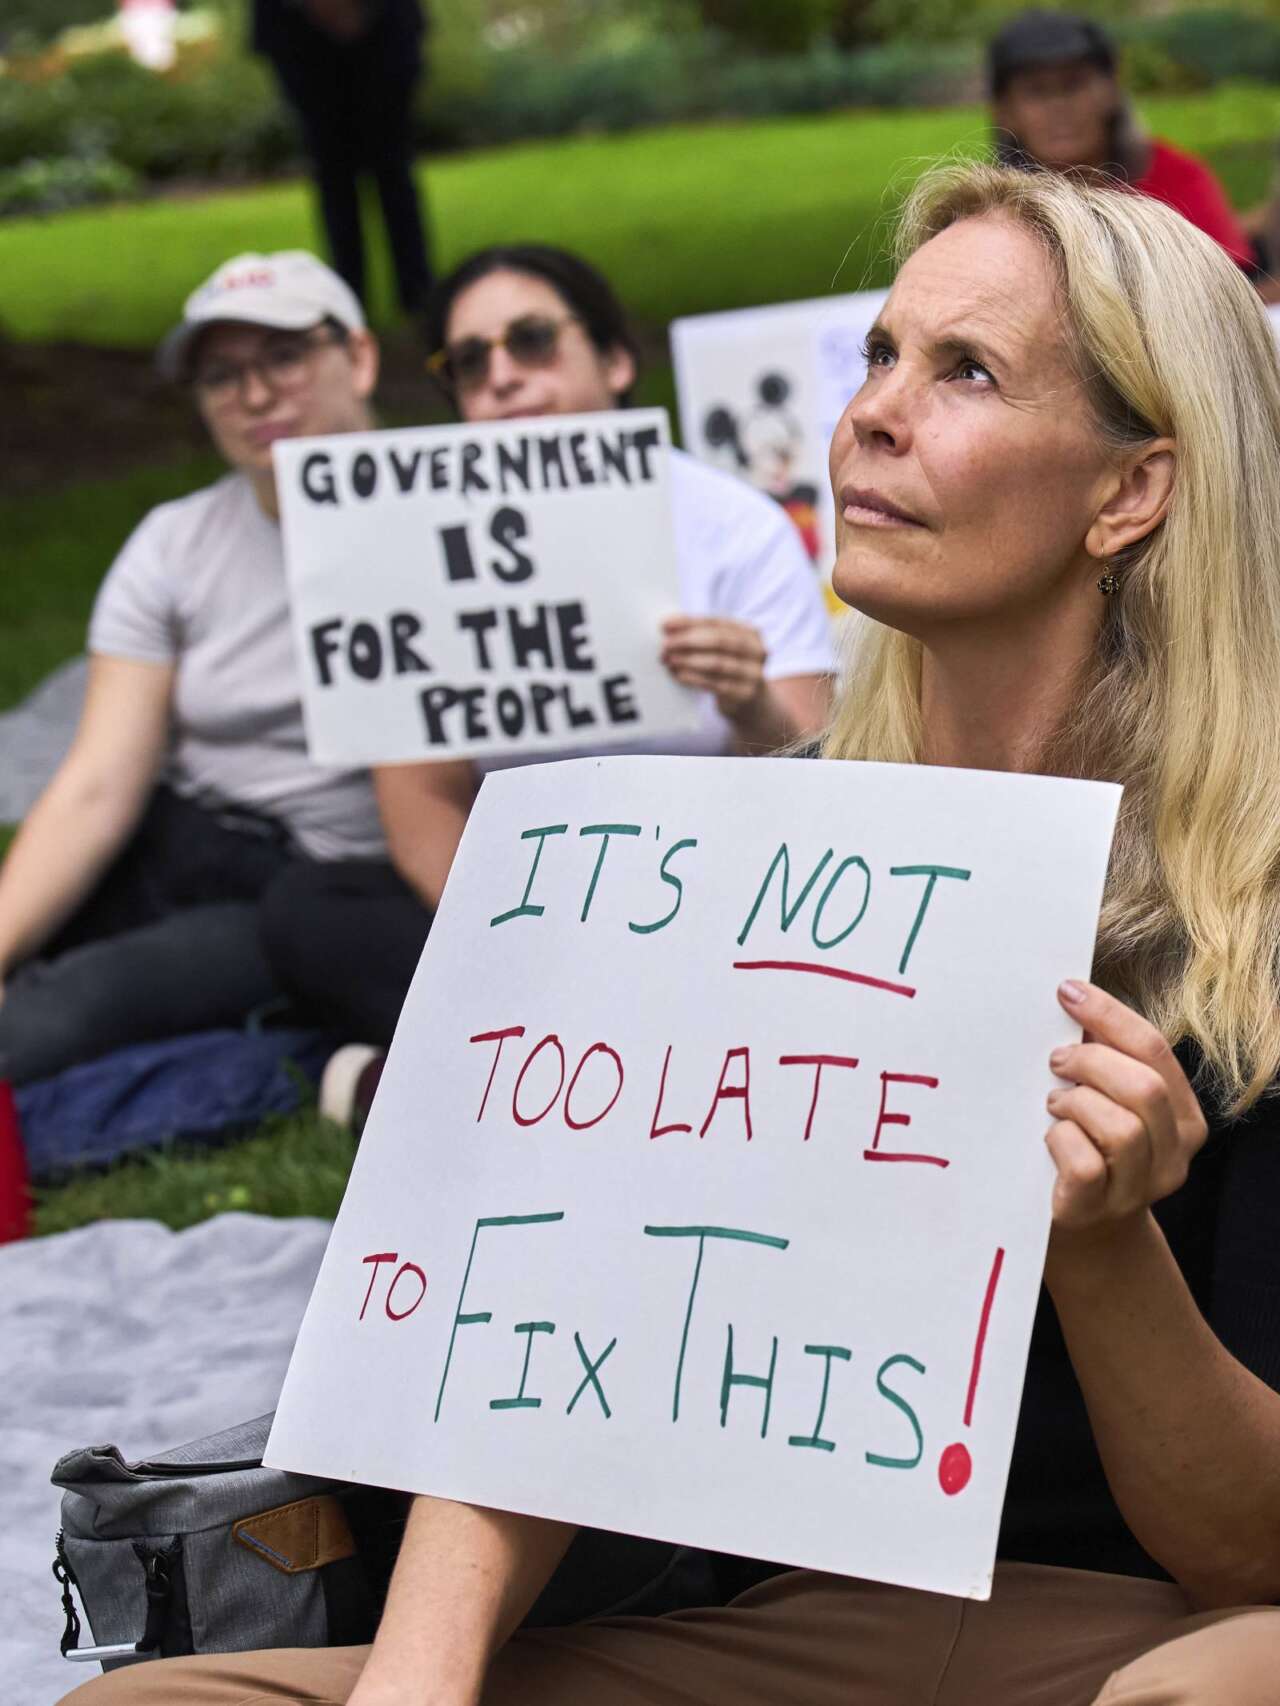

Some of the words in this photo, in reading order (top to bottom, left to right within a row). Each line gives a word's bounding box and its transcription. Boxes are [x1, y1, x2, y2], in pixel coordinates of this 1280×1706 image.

[301, 425, 661, 506] GOVERNMENT
[438, 505, 536, 585] IS
[310, 611, 432, 687] FOR
[456, 602, 596, 674] THE
[419, 673, 640, 746] PEOPLE
[490, 824, 698, 935] IT'S
[737, 843, 972, 975] NOT
[468, 1026, 624, 1131] TOO
[649, 1044, 951, 1169] LATE
[358, 1252, 428, 1321] TO
